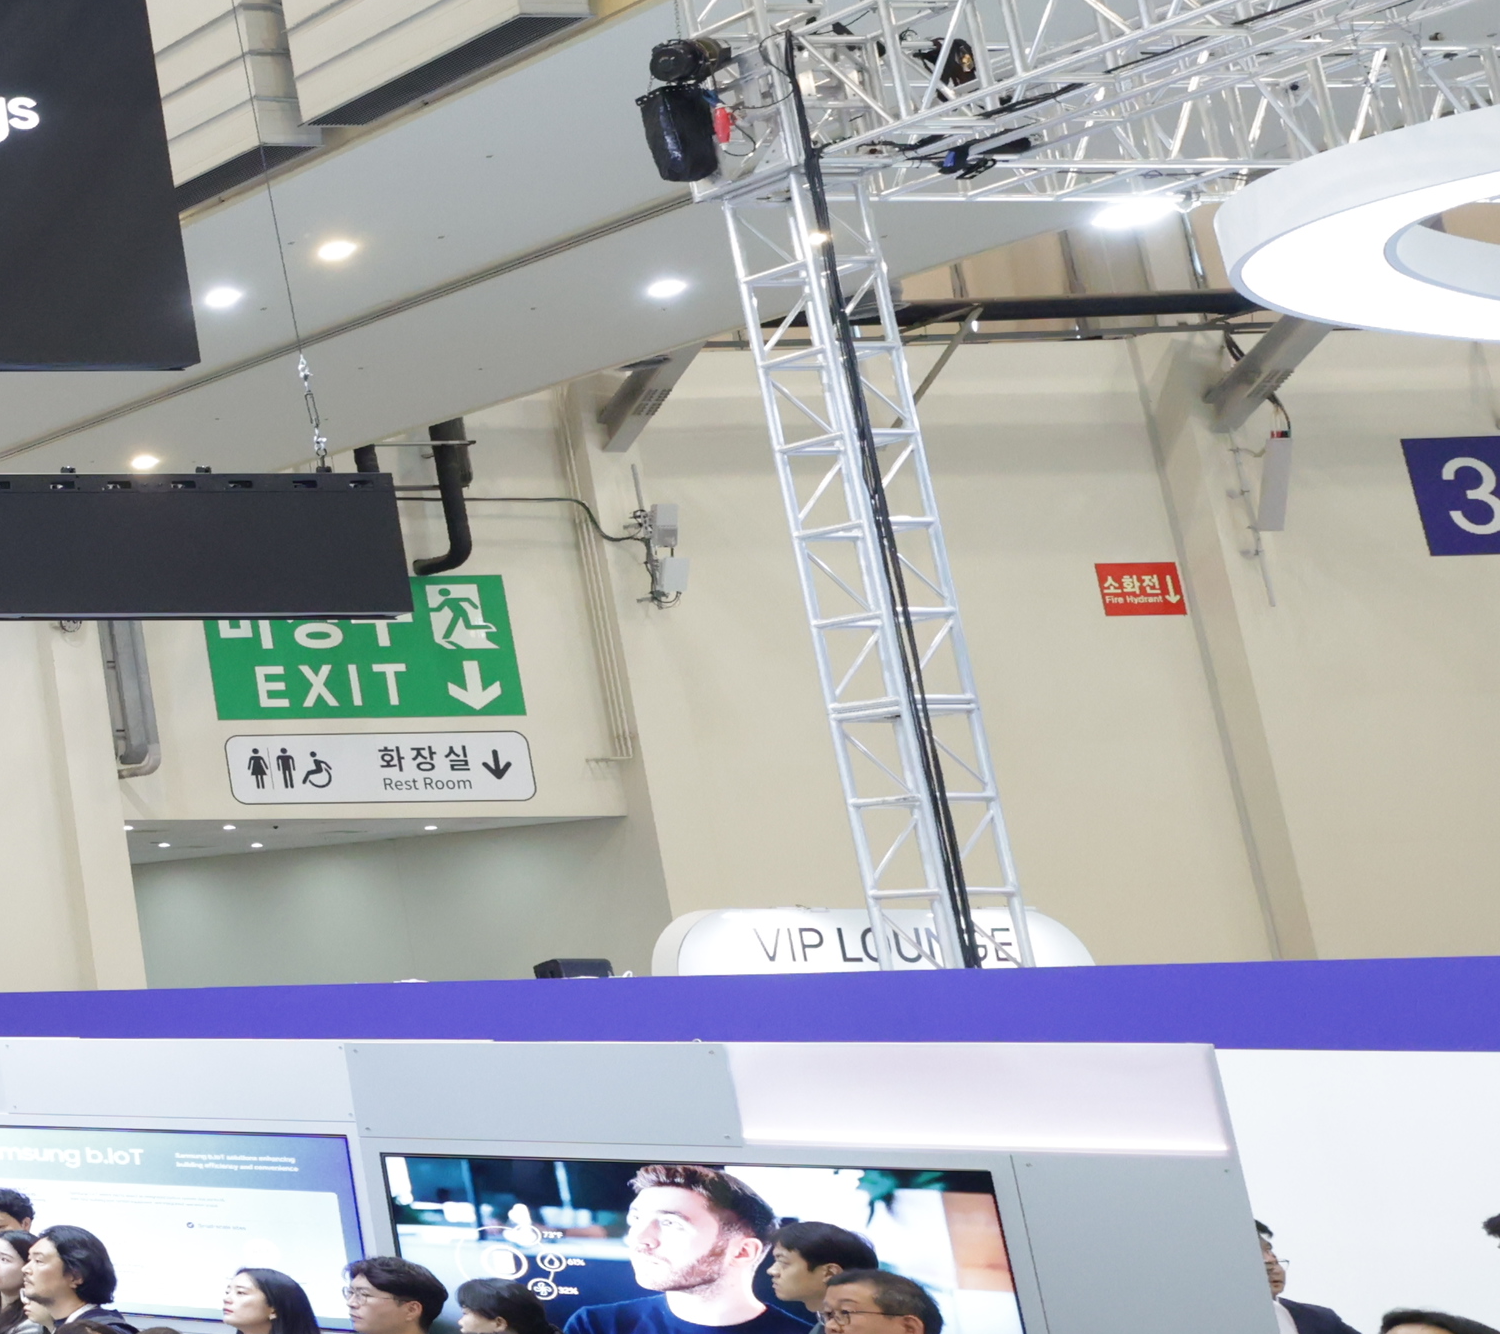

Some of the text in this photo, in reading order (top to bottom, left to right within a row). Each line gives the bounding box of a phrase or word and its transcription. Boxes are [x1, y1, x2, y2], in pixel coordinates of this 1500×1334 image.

[1103, 575, 1161, 595] 소화전
[1105, 593, 1163, 606] Fire Hydrant
[255, 663, 407, 708] EXIT
[378, 745, 471, 773] 화장실
[383, 777, 473, 791] Rest Room
[753, 927, 824, 962] VIP
[86, 1146, 144, 1165] b.IoT
[175, 1152, 207, 1162] Samsung
[253, 1165, 299, 1173] convenience
